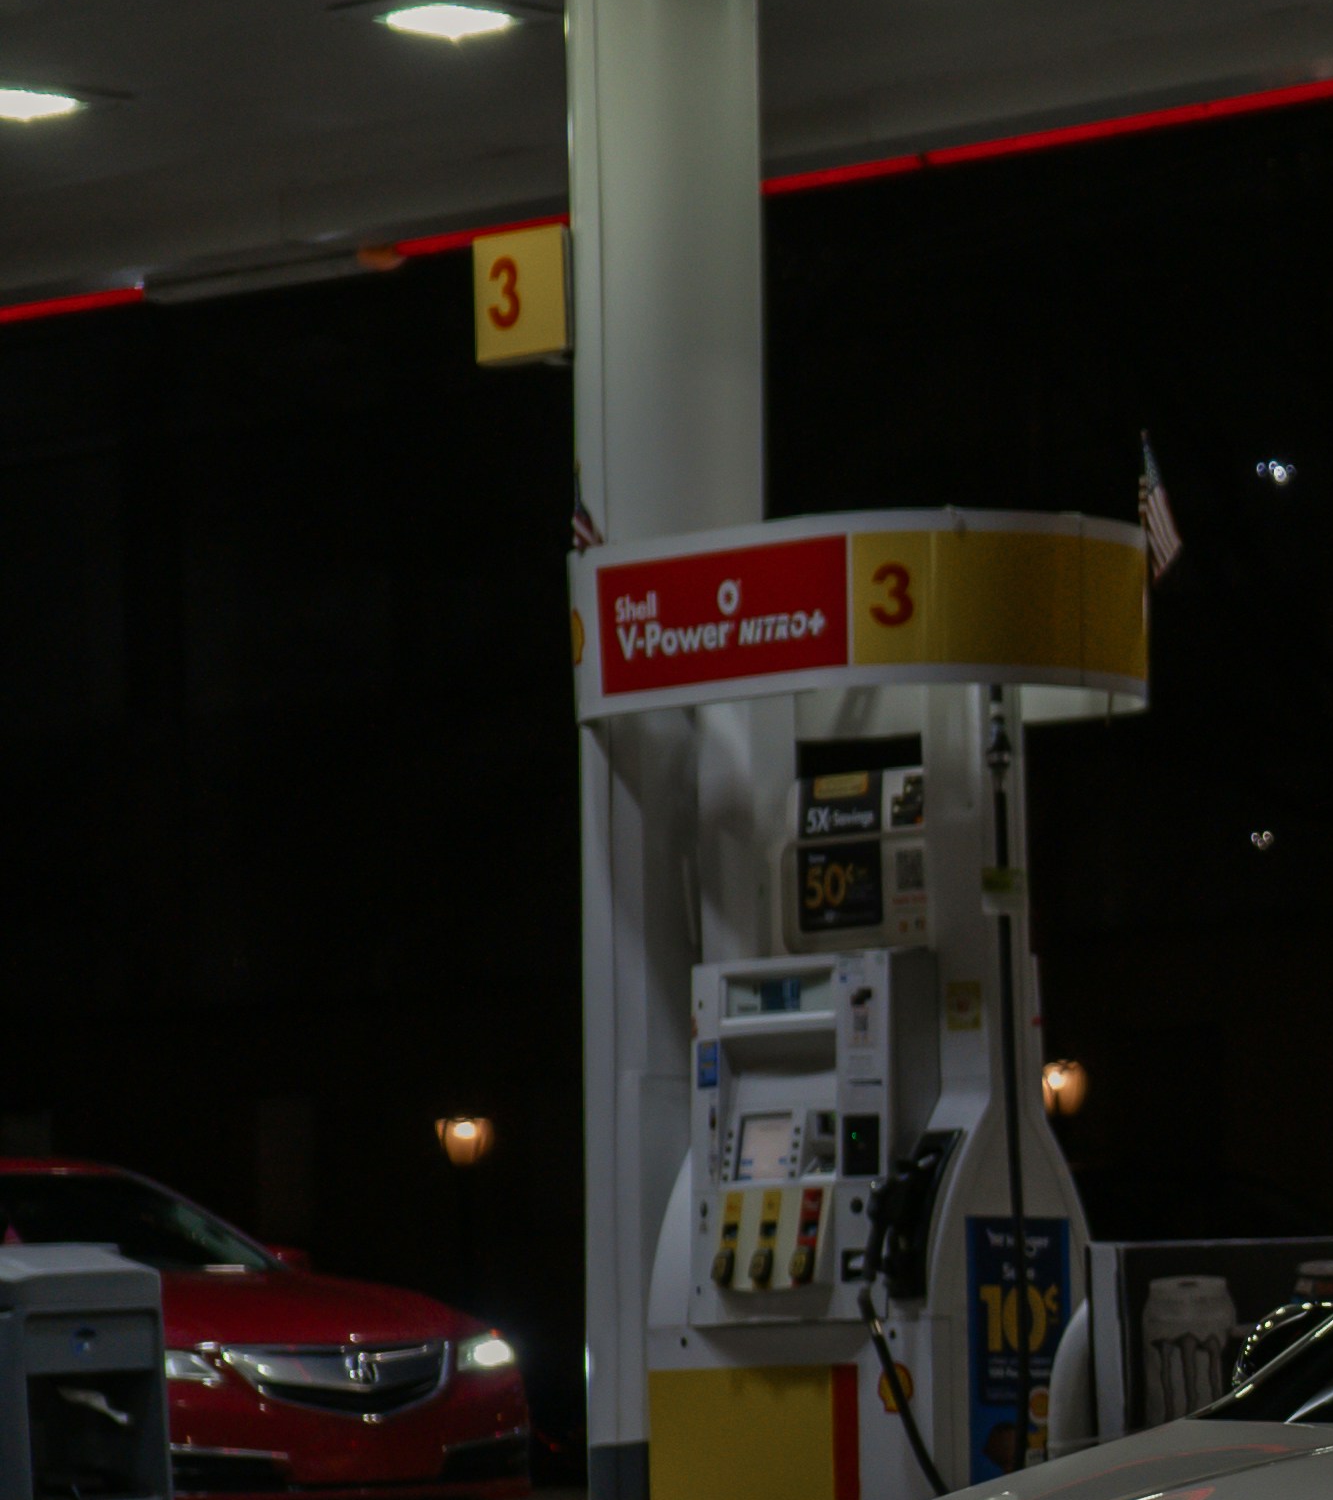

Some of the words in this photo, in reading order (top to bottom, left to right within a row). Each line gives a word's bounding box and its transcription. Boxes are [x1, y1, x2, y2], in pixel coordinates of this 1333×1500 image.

[488, 256, 521, 331] 3
[613, 589, 659, 624] Shell
[868, 560, 915, 627] 3
[615, 618, 732, 663] V-Power
